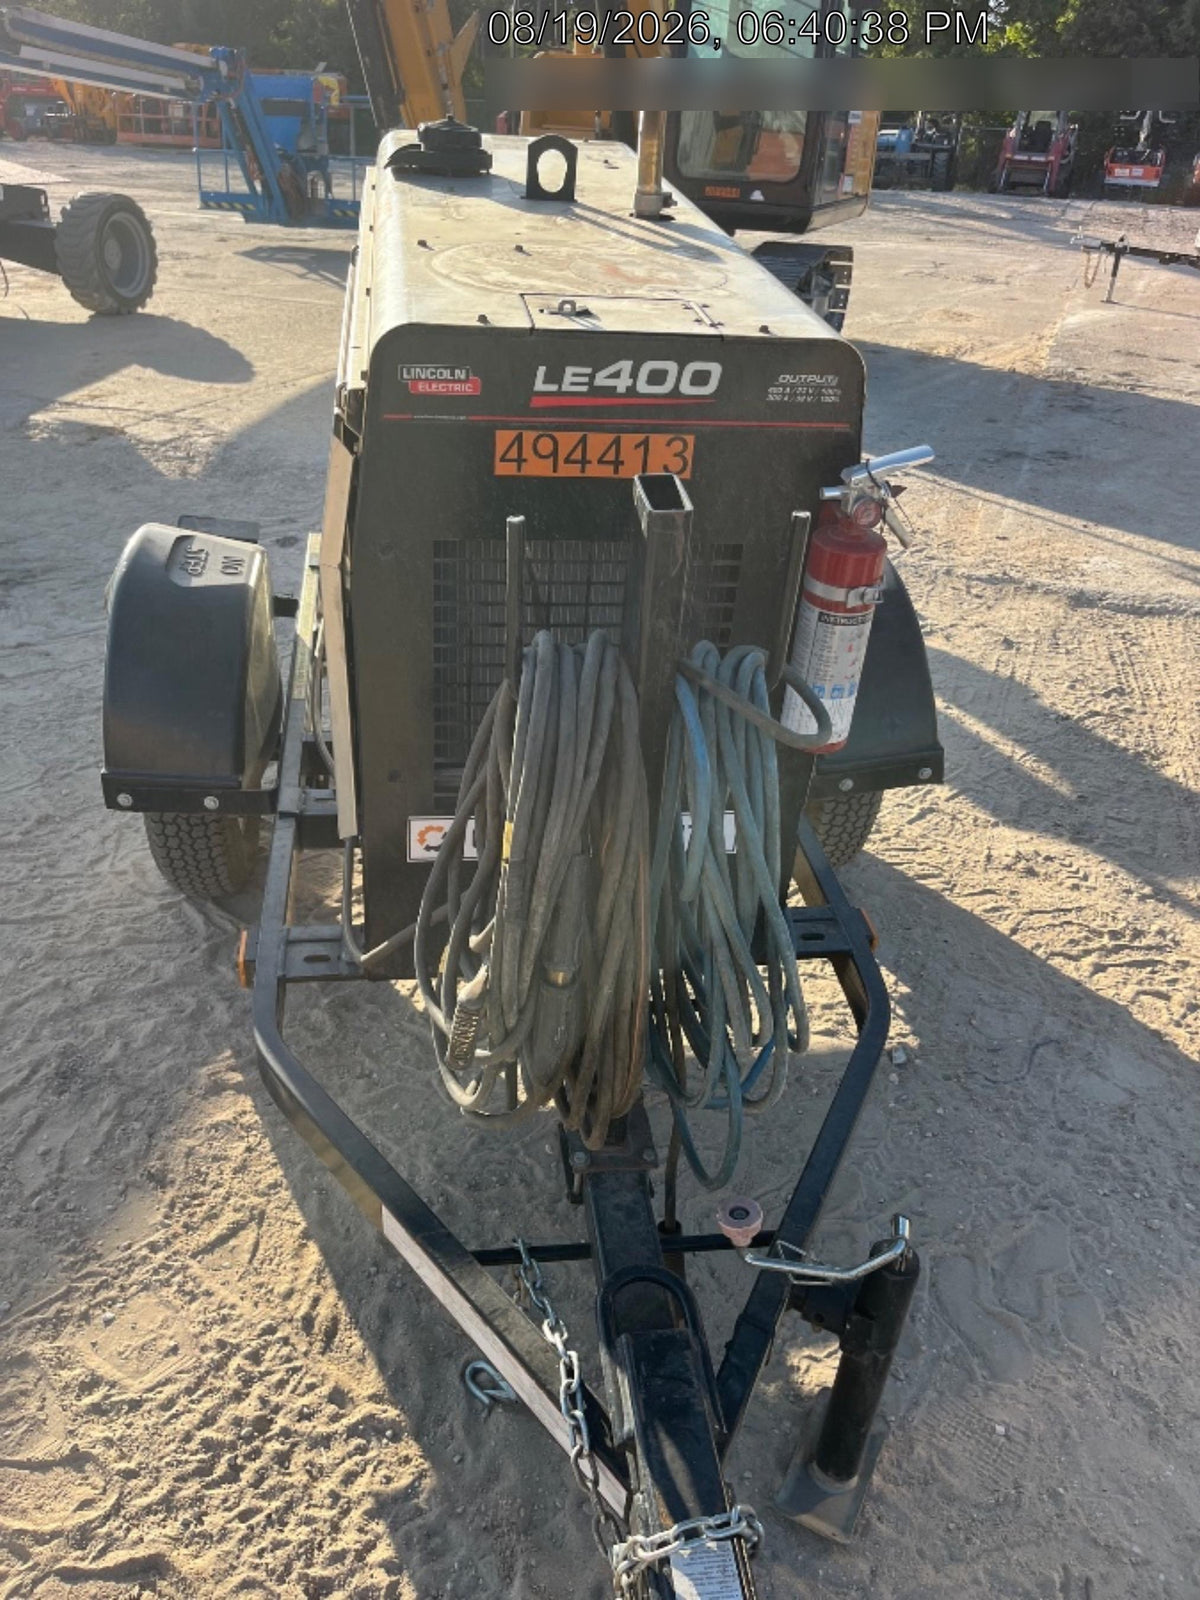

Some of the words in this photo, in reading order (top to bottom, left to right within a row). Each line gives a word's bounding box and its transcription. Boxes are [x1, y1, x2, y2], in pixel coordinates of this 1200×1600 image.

[402, 367, 467, 379] LINCOLN
[533, 360, 723, 395] LE400
[778, 374, 836, 384] OUTPUT
[418, 383, 473, 392] ELECTRIC
[499, 431, 689, 475] 494413
